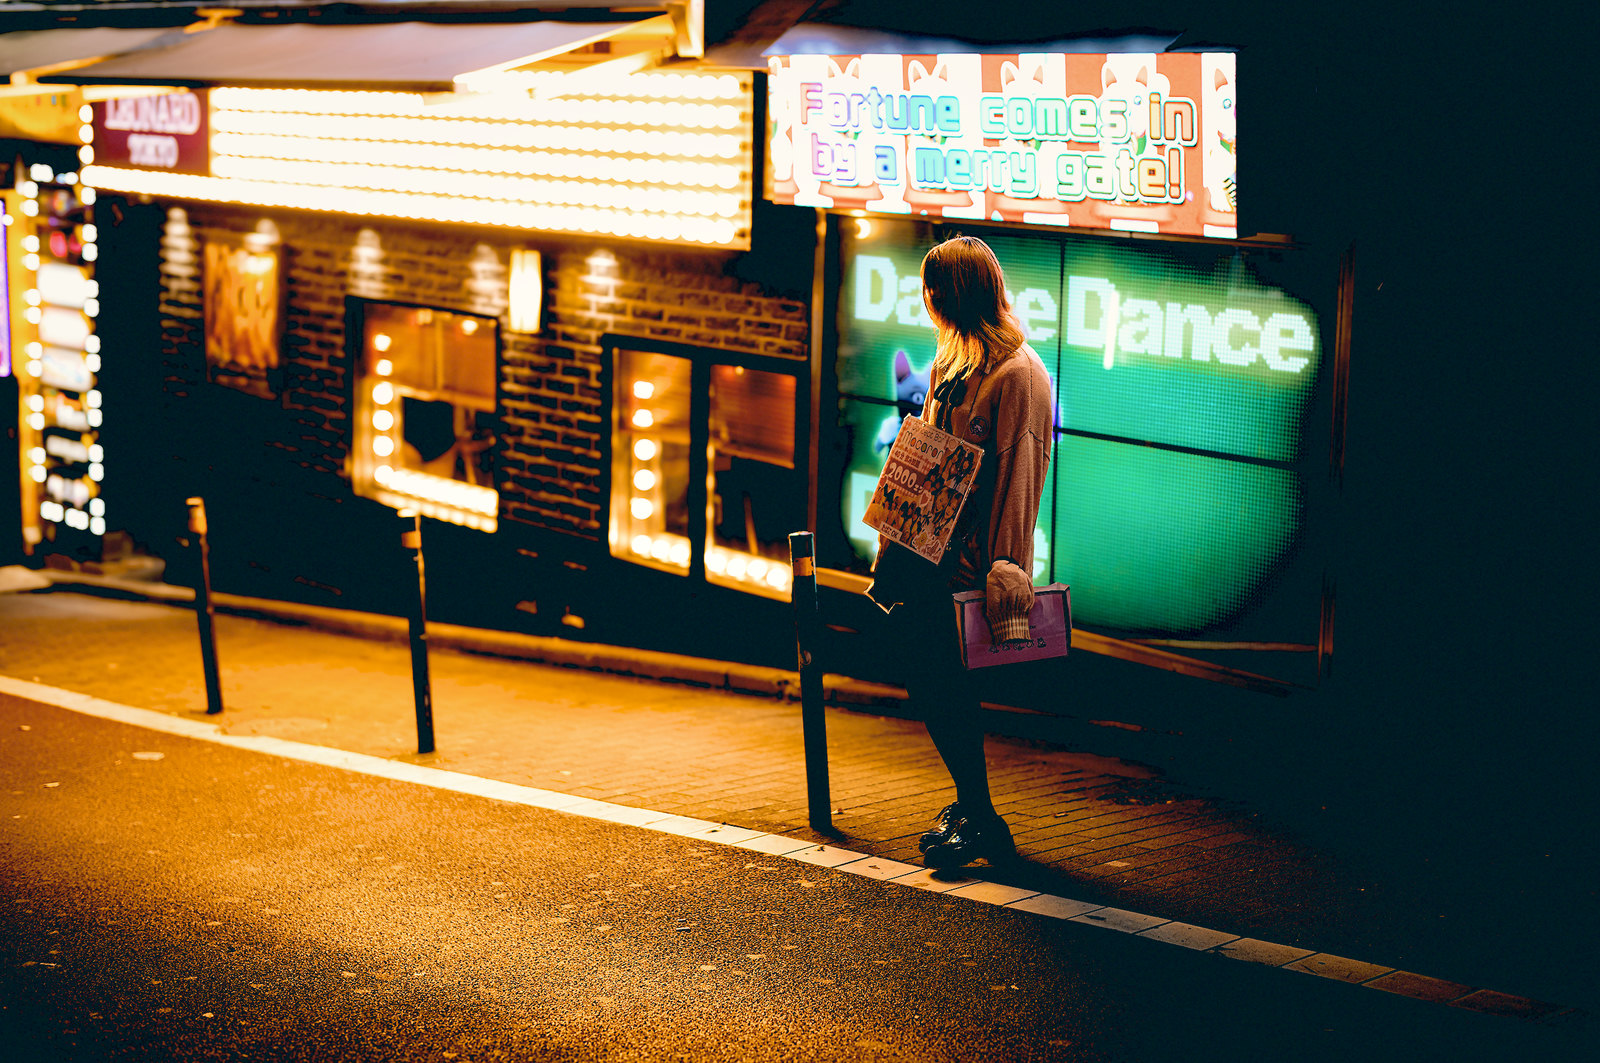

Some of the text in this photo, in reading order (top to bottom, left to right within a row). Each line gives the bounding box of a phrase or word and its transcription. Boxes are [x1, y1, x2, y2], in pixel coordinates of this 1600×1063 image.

[800, 82, 1194, 141] Fortune comes in
[811, 132, 1181, 199] by a merry gate!
[854, 254, 1314, 373] Dae Dance
